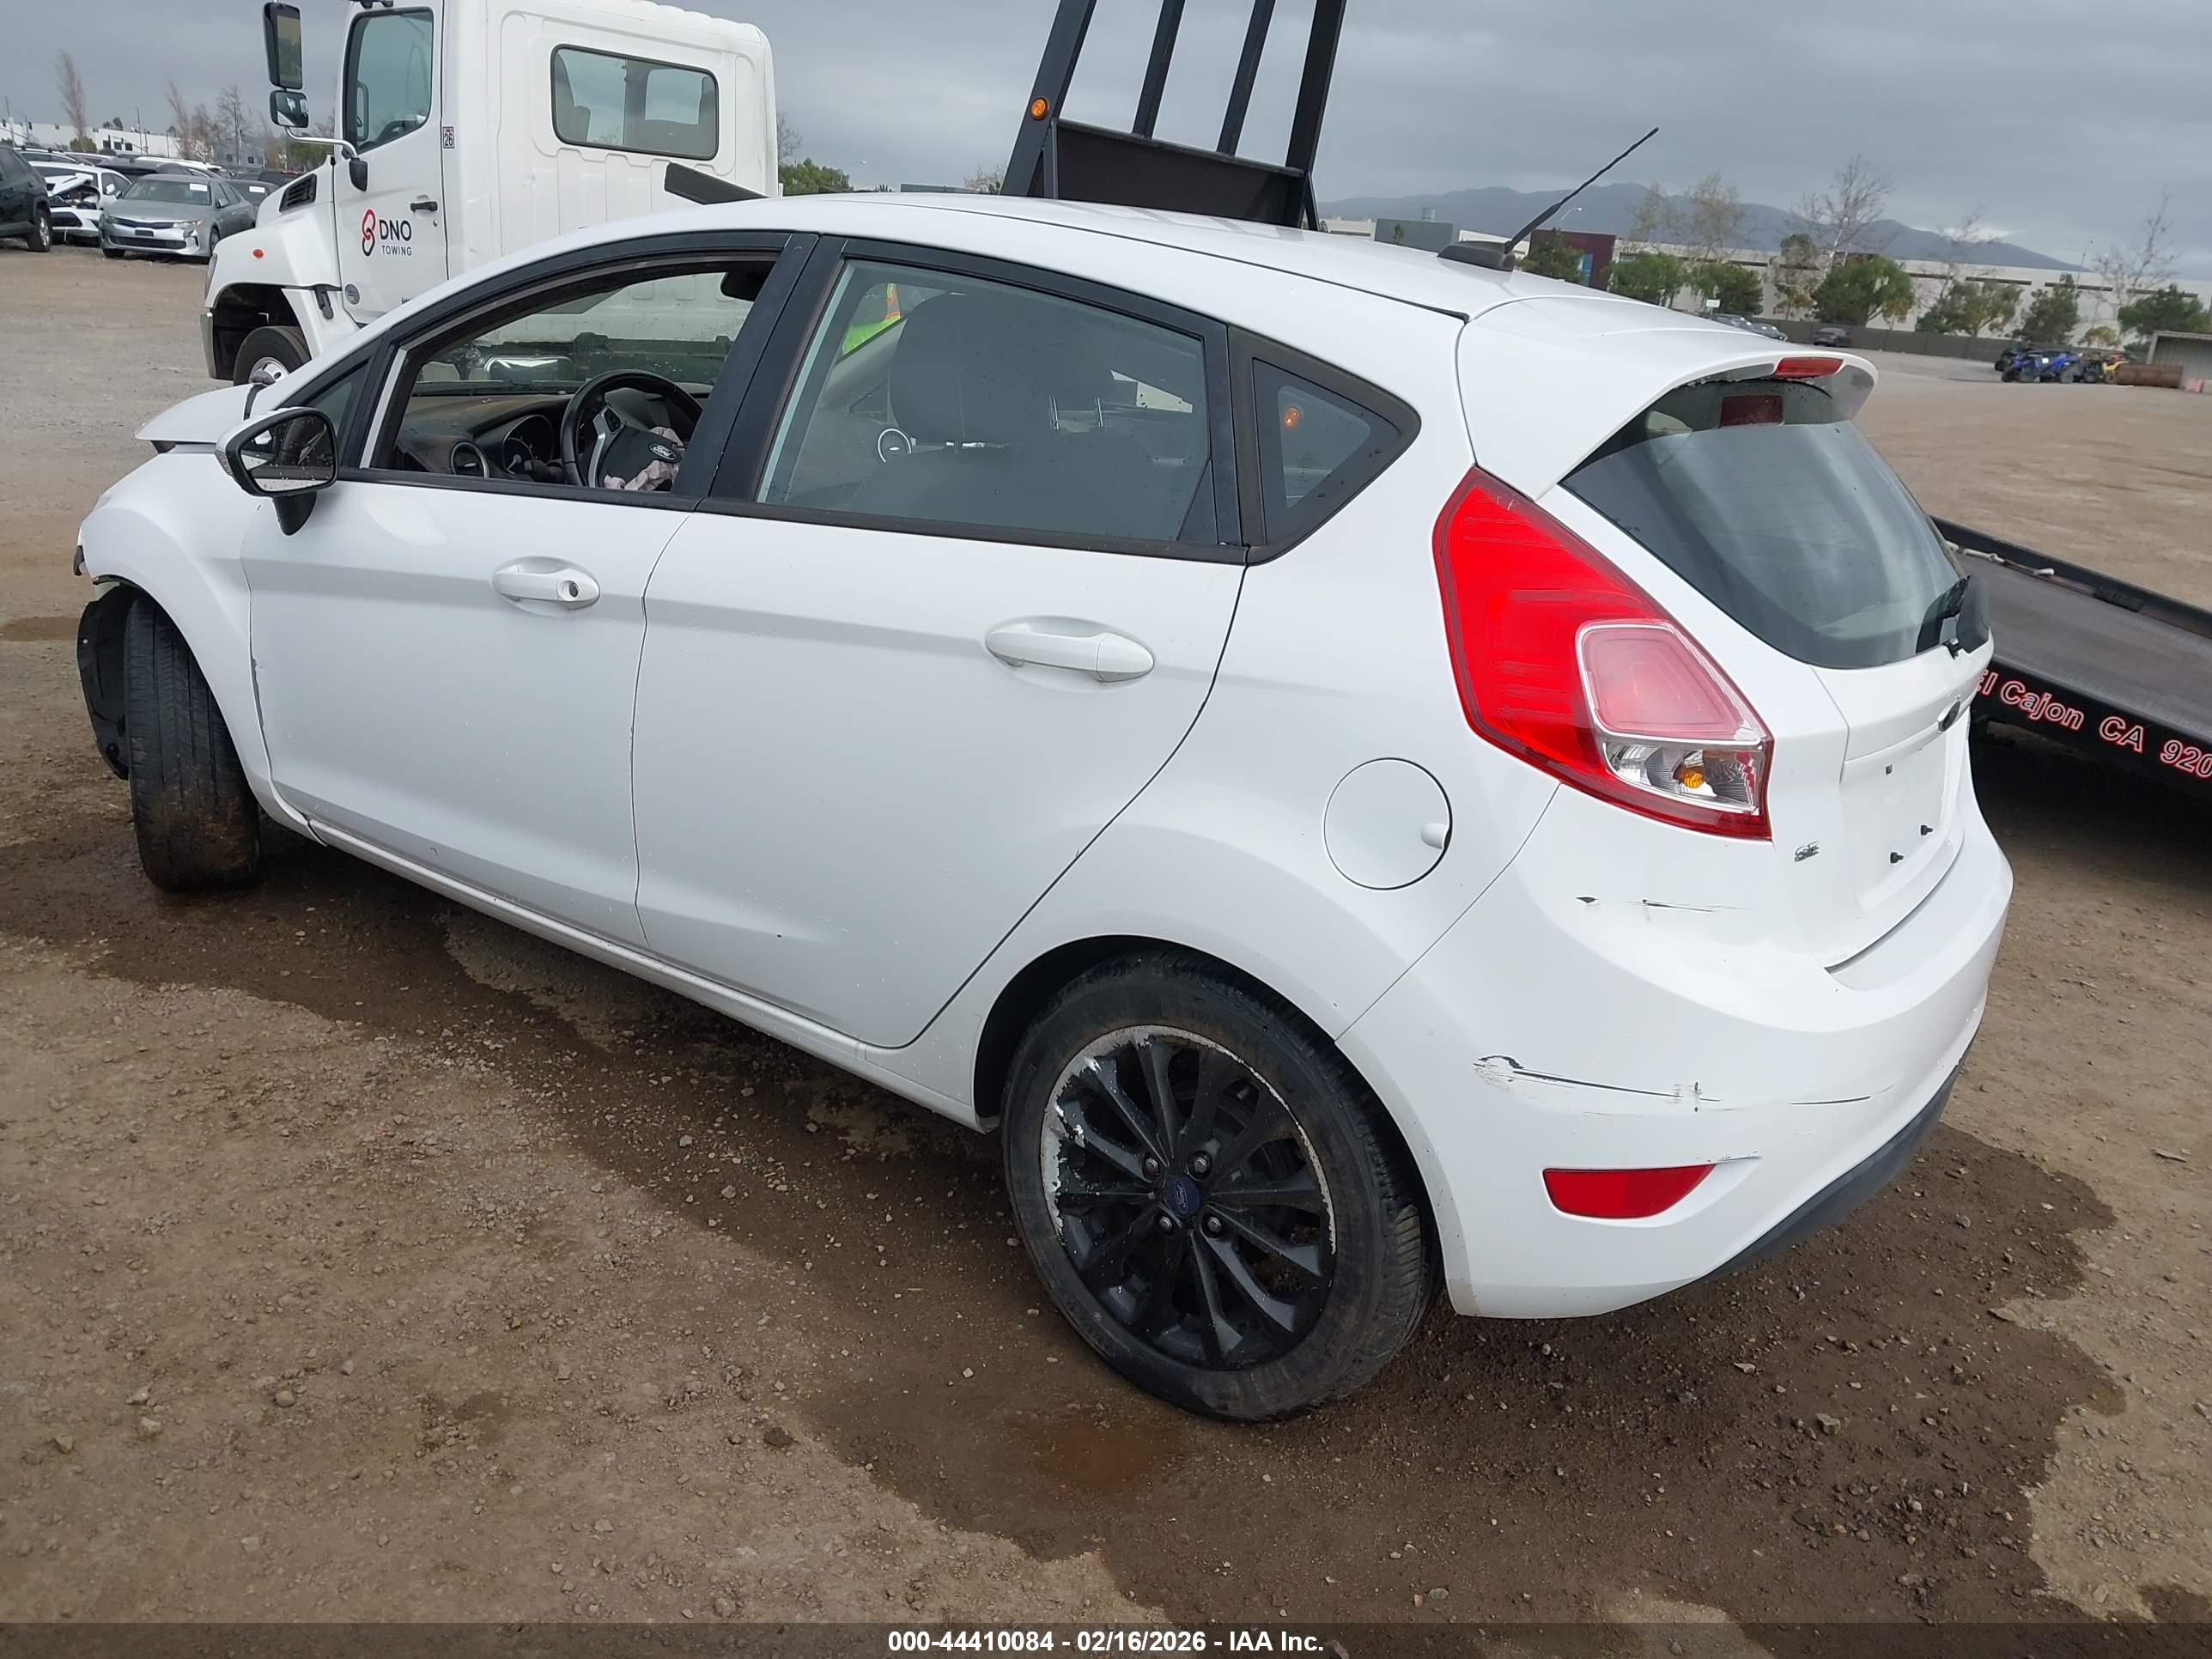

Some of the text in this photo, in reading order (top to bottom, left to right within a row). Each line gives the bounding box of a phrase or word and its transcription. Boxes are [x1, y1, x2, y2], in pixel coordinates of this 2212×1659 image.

[444, 133, 453, 147] 26
[380, 219, 412, 241] DNO
[381, 246, 412, 256] TOWING
[653, 445, 672, 457] Ford
[2001, 680, 2085, 730] Cajon
[2099, 716, 2144, 752] CA
[2160, 739, 2212, 778] 920
